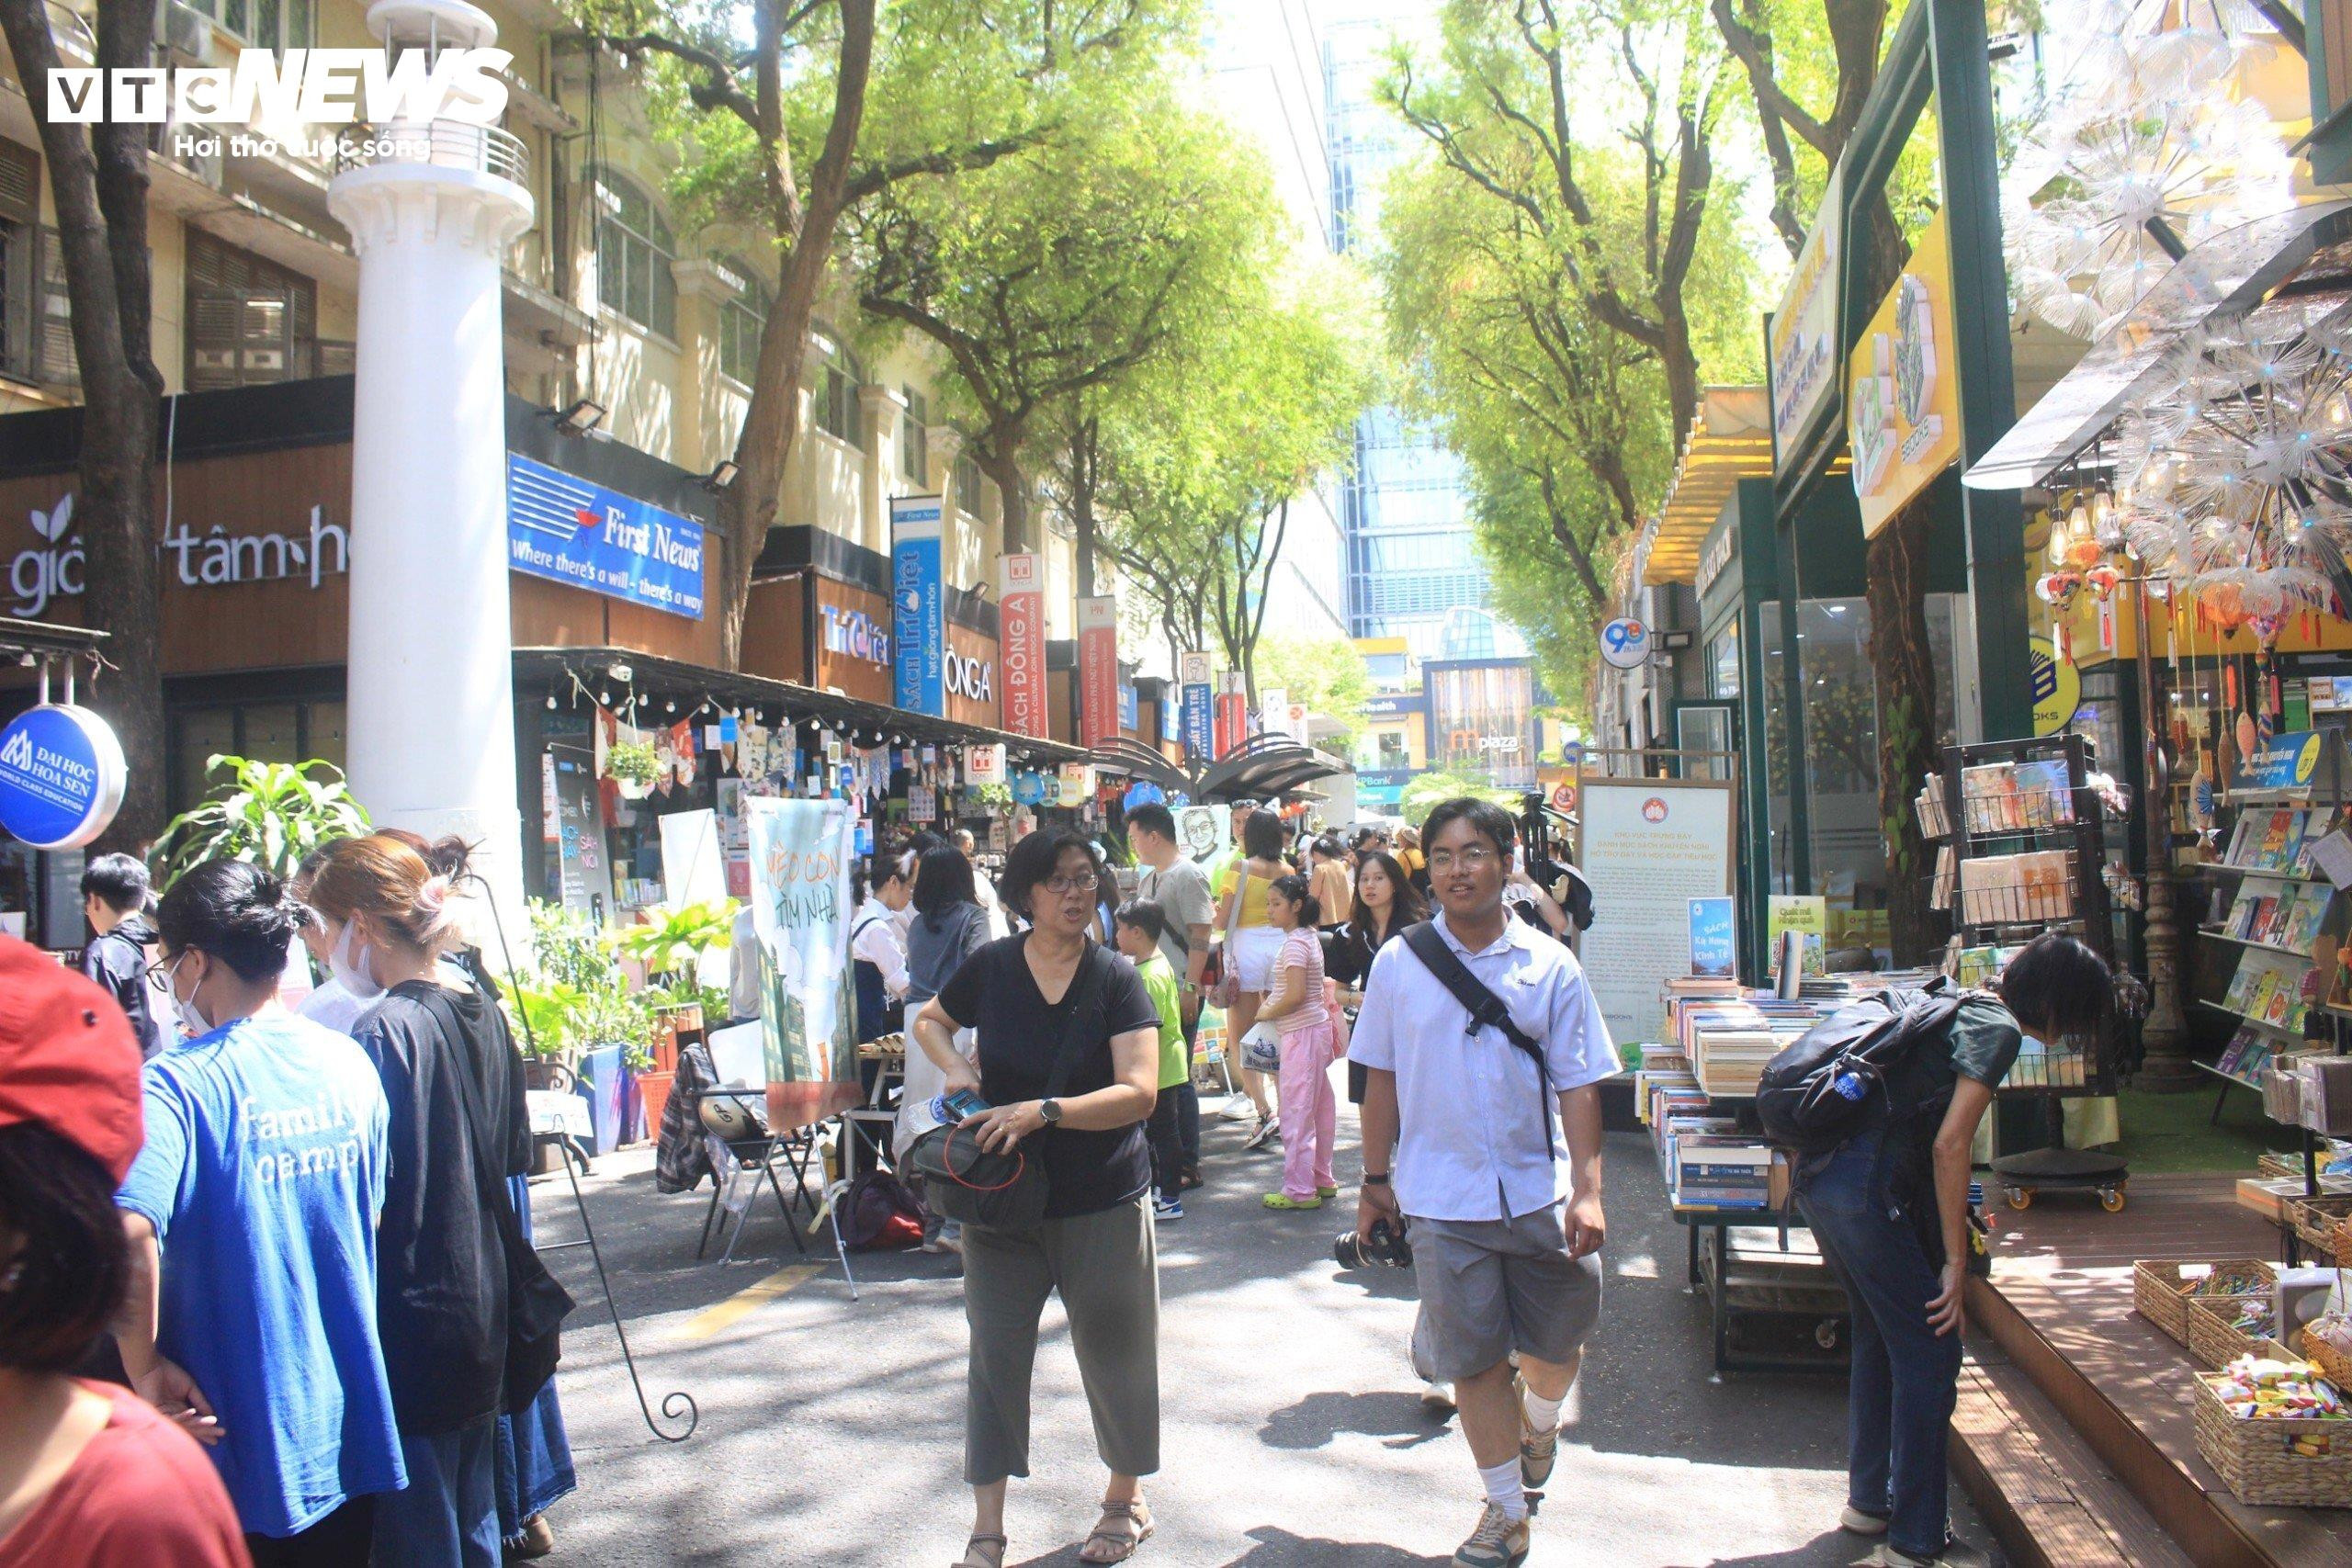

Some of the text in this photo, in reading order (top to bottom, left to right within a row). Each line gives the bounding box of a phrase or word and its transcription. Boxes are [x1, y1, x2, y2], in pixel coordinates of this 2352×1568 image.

[603, 505, 700, 572] First News
[513, 539, 553, 568] Where
[555, 550, 596, 581] there's
[598, 569, 606, 583] a
[608, 570, 628, 590] will
[639, 577, 673, 602] there's
[674, 591, 682, 604] a
[683, 592, 703, 614] way
[1008, 597, 1024, 613] A
[944, 643, 989, 703] ÔNGA
[1005, 618, 1027, 686] ĐÔNG
[1478, 735, 1518, 751] plaza
[31, 762, 92, 798] HOA SEN
[805, 845, 841, 884] CON
[805, 883, 839, 928] NHÀ
[239, 1091, 365, 1145] family
[255, 1139, 359, 1183] camp
